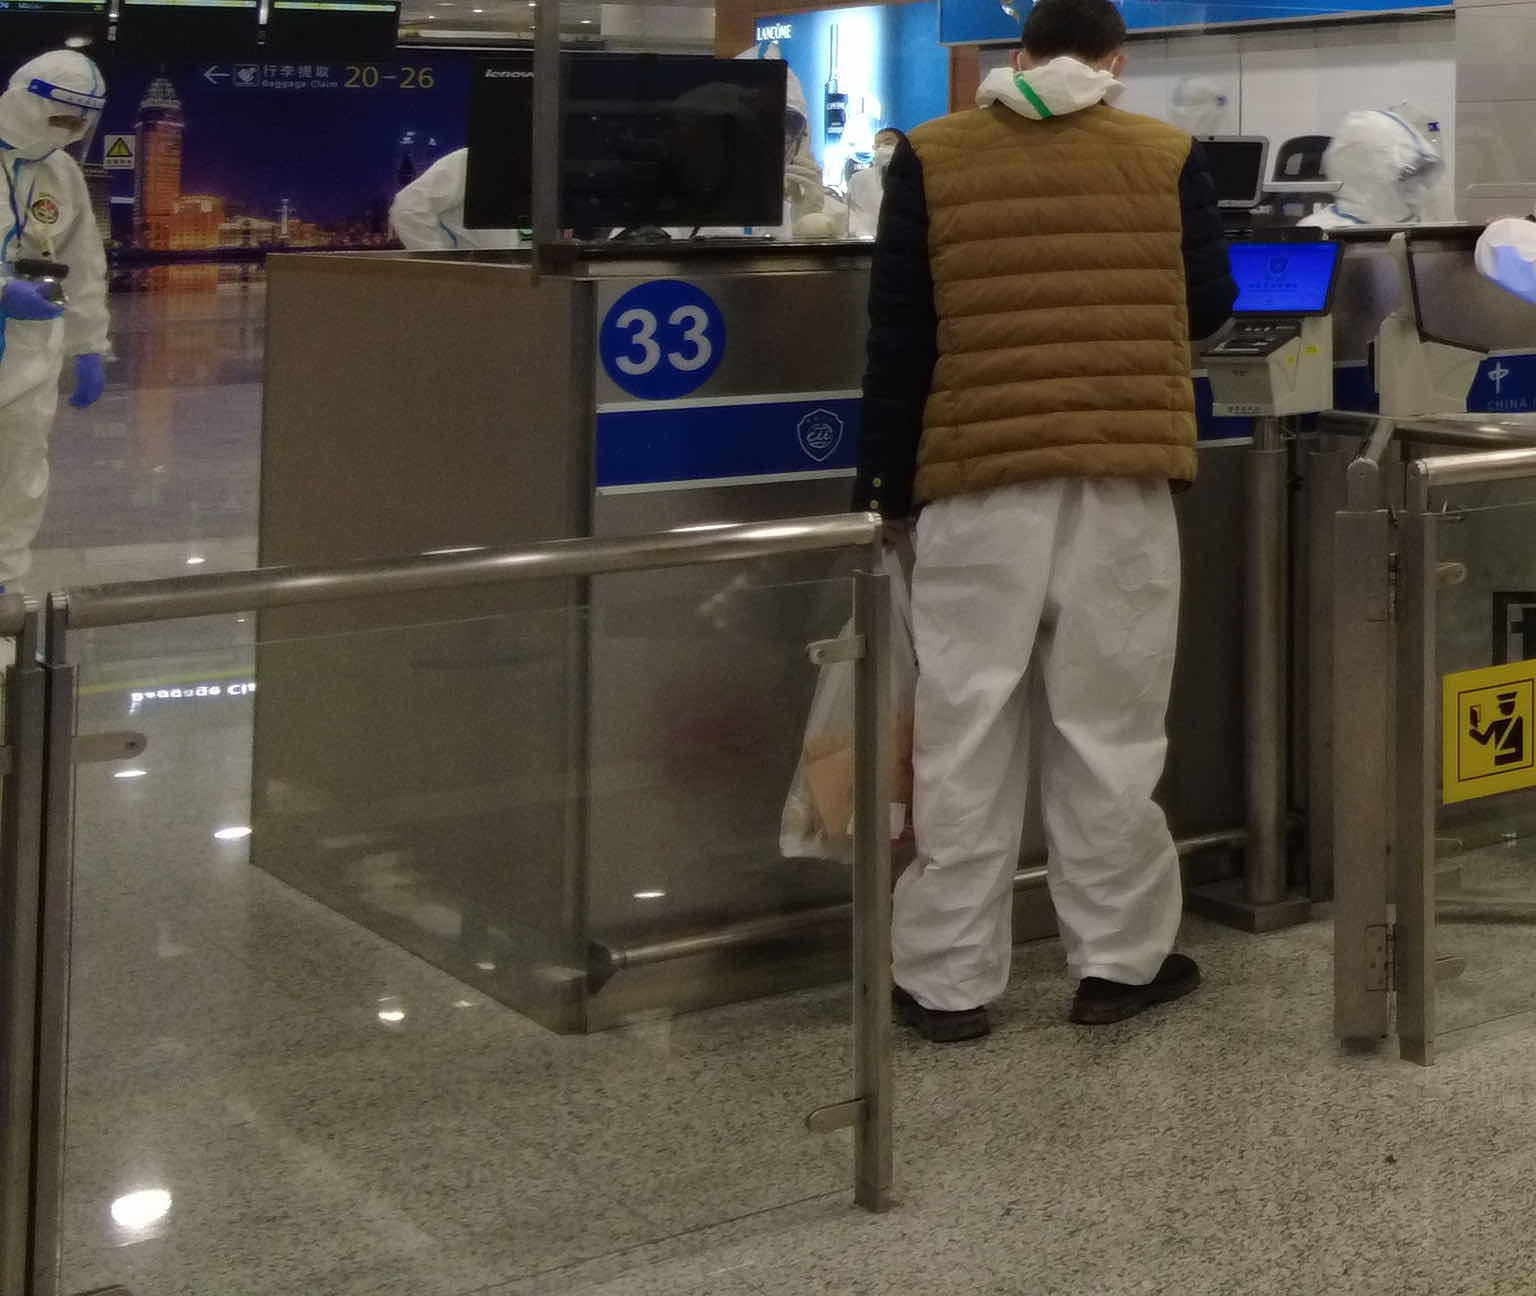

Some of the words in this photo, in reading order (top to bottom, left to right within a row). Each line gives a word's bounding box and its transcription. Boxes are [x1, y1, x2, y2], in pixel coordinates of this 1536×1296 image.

[263, 65, 329, 78] 行李提取
[615, 305, 712, 375] 33
